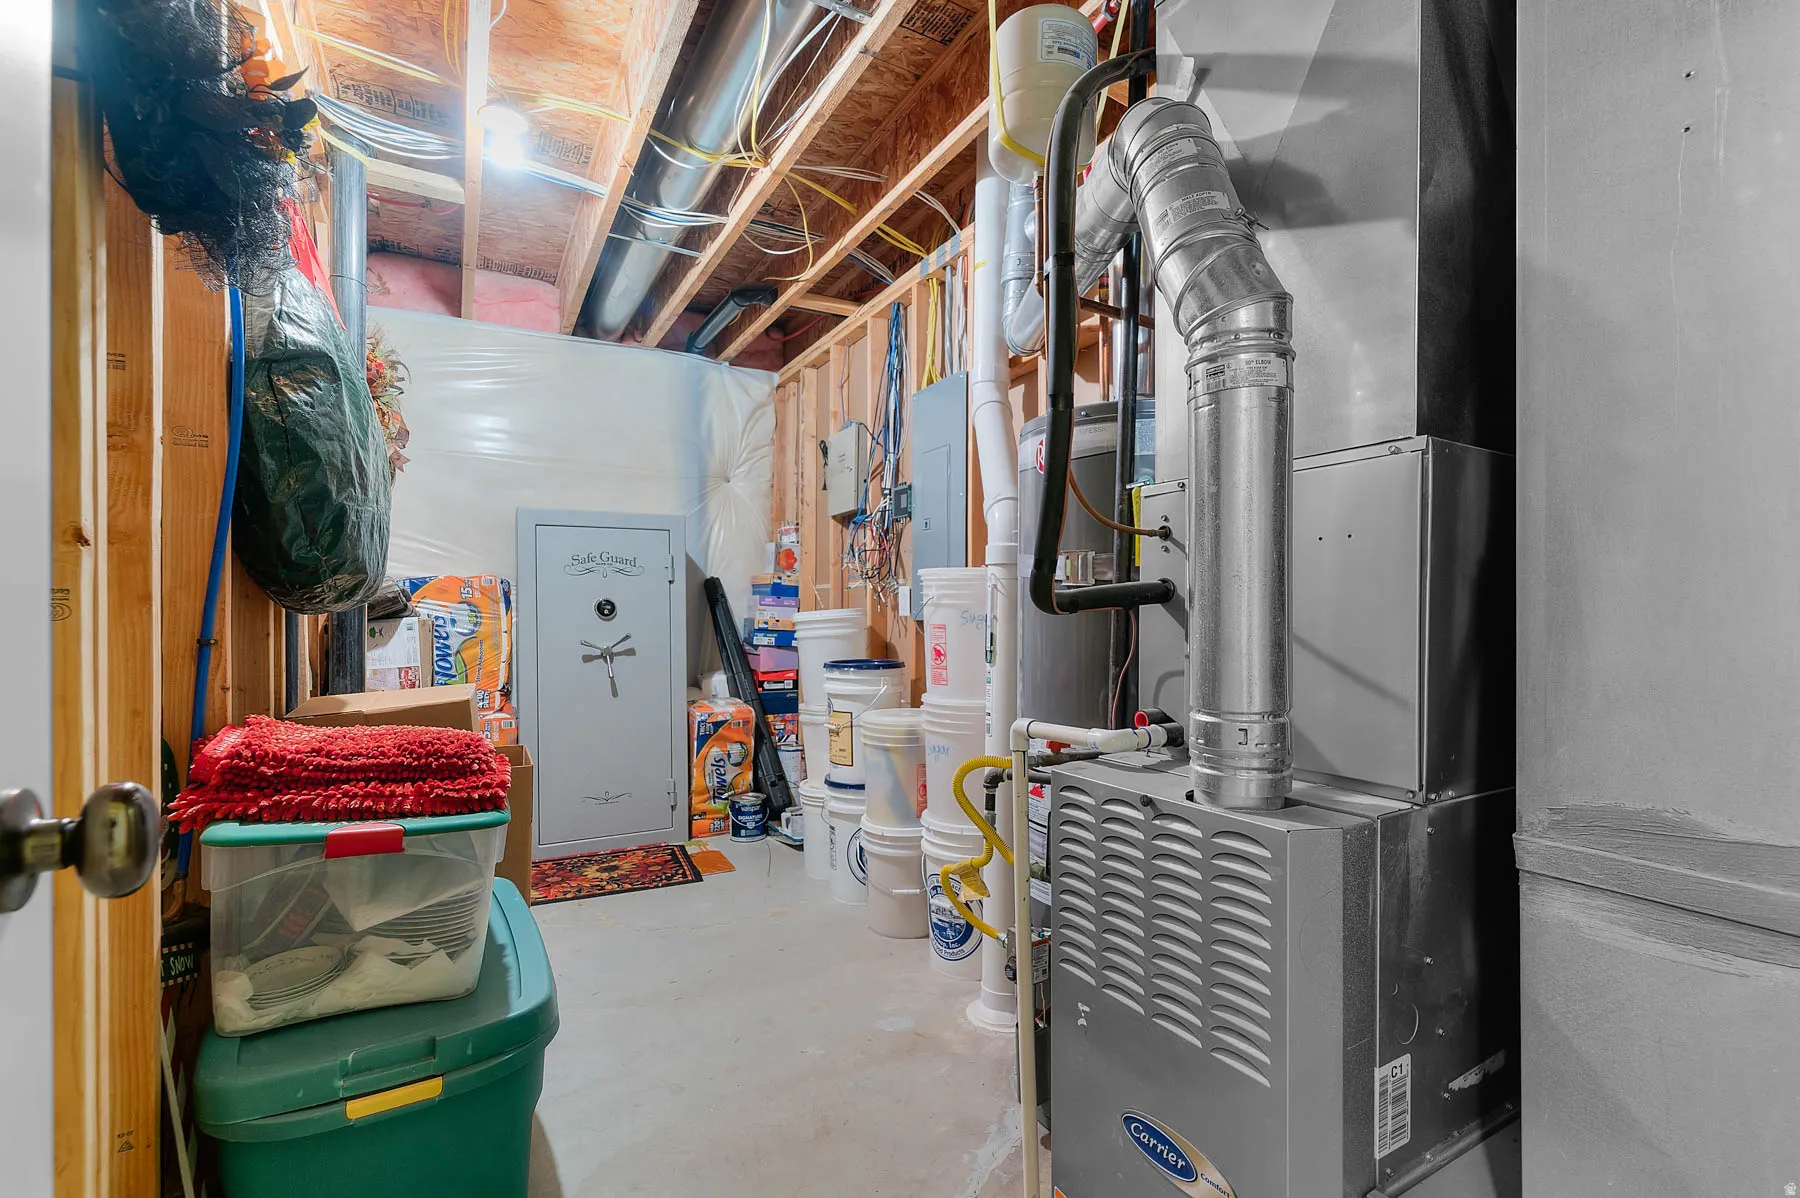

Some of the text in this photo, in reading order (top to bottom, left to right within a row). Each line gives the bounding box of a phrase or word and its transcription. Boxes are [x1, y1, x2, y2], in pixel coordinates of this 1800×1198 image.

[571, 551, 637, 568] Safe Guard
[960, 610, 986, 631] Sug
[475, 667, 483, 683] Strong
[710, 757, 729, 806] Towels
[170, 953, 194, 976] SNOW
[1391, 1063, 1403, 1078] C1
[1130, 1123, 1186, 1169] Carrier
